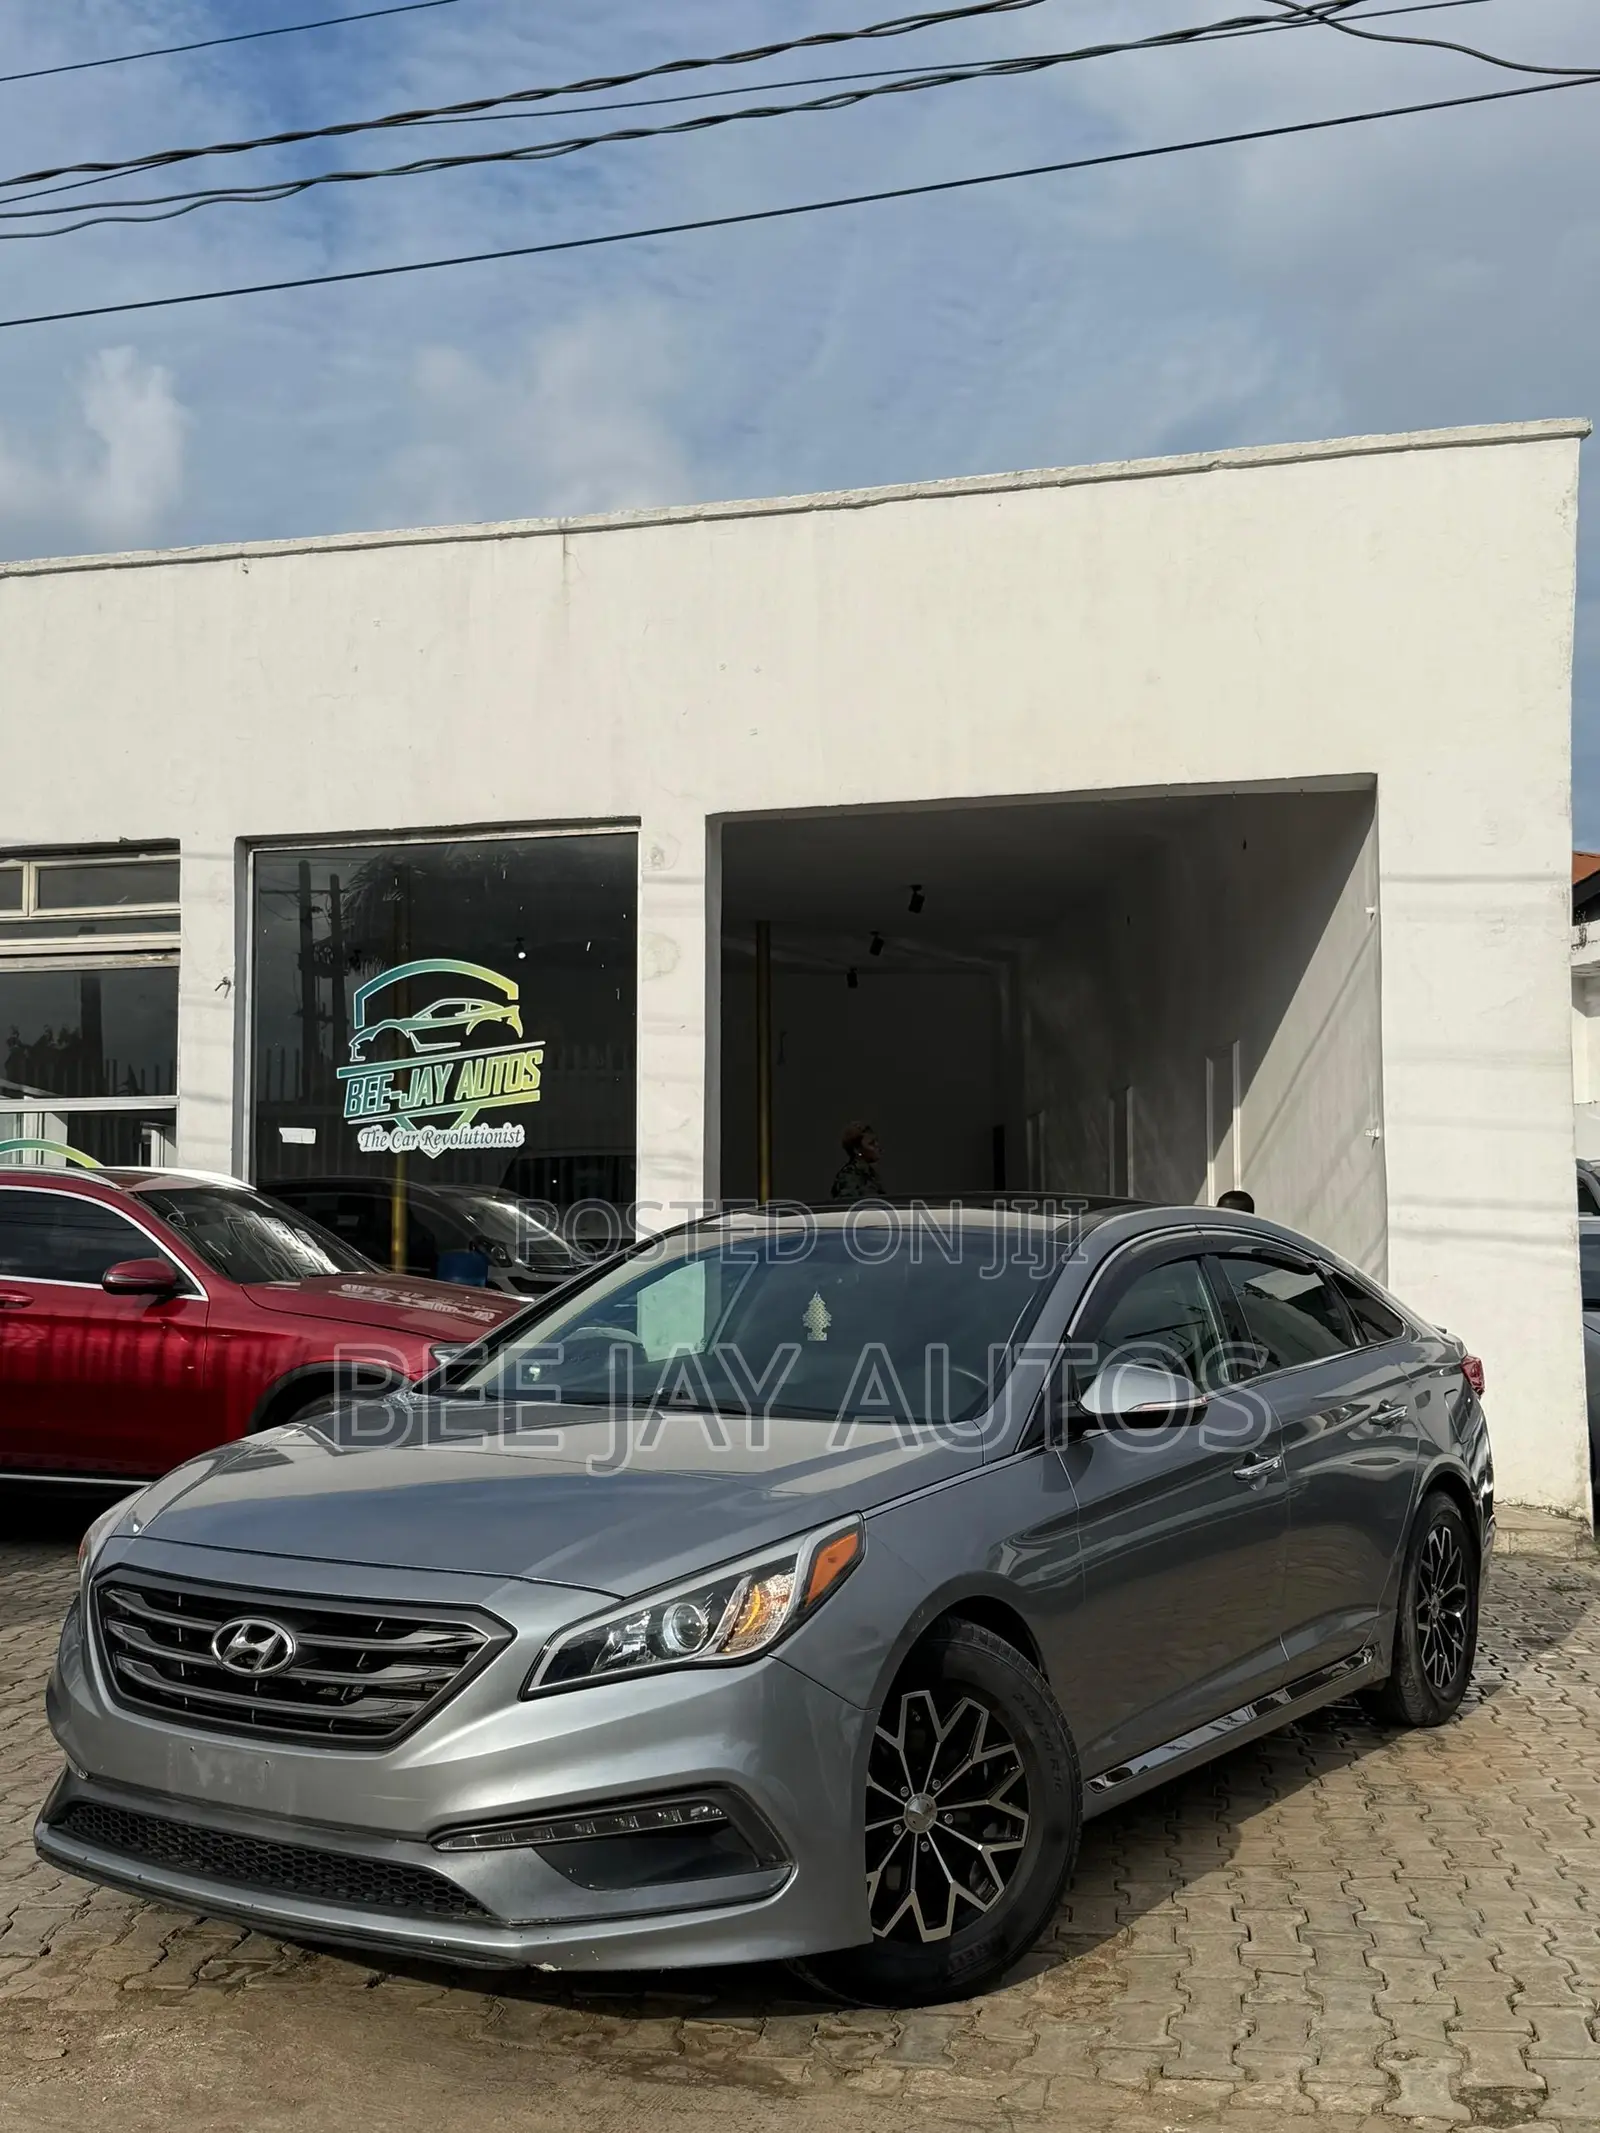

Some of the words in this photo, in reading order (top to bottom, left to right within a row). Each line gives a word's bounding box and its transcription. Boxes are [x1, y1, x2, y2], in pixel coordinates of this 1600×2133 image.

[344, 1063, 453, 1118] BEE-JAY
[454, 1050, 543, 1101] AUTOS
[361, 1129, 387, 1148] The
[391, 1130, 418, 1149] Car
[422, 1125, 522, 1146] Revolutionist
